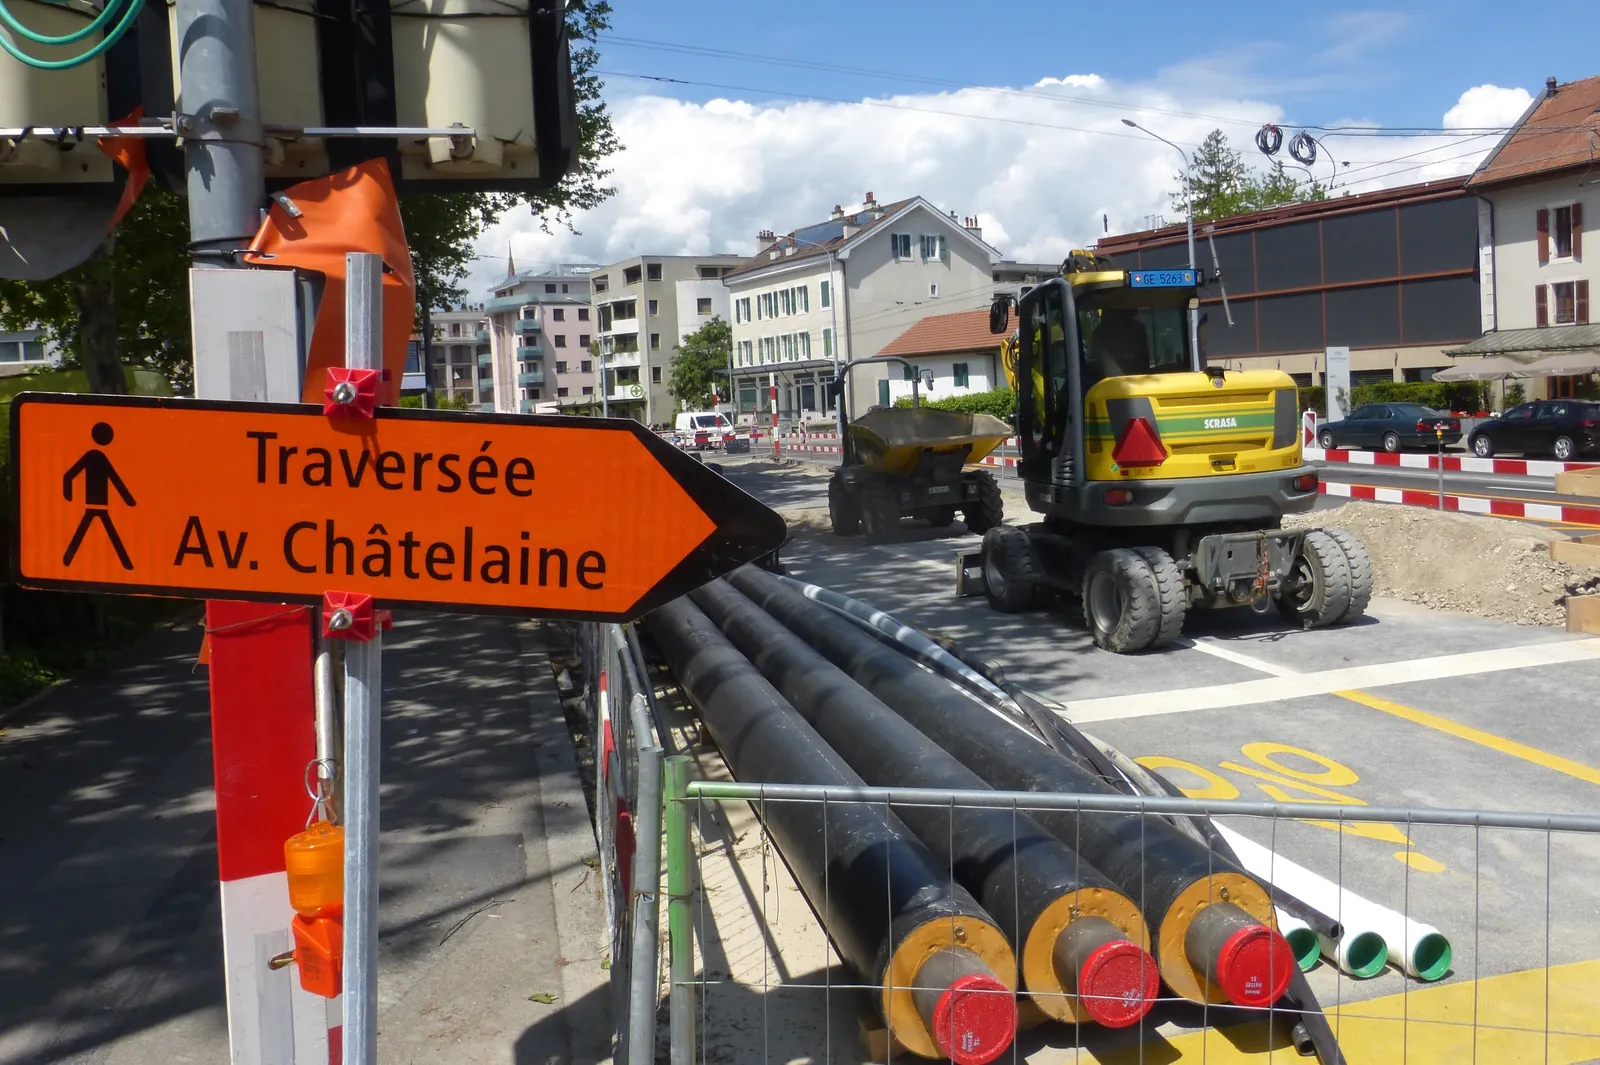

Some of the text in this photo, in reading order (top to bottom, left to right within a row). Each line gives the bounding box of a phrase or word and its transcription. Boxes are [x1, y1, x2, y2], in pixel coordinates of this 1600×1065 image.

[1143, 273, 1183, 285] GE 5263
[1204, 417, 1237, 429] SCRASA
[246, 430, 535, 498] Traversée
[173, 515, 607, 591] Av. Châtelaine
